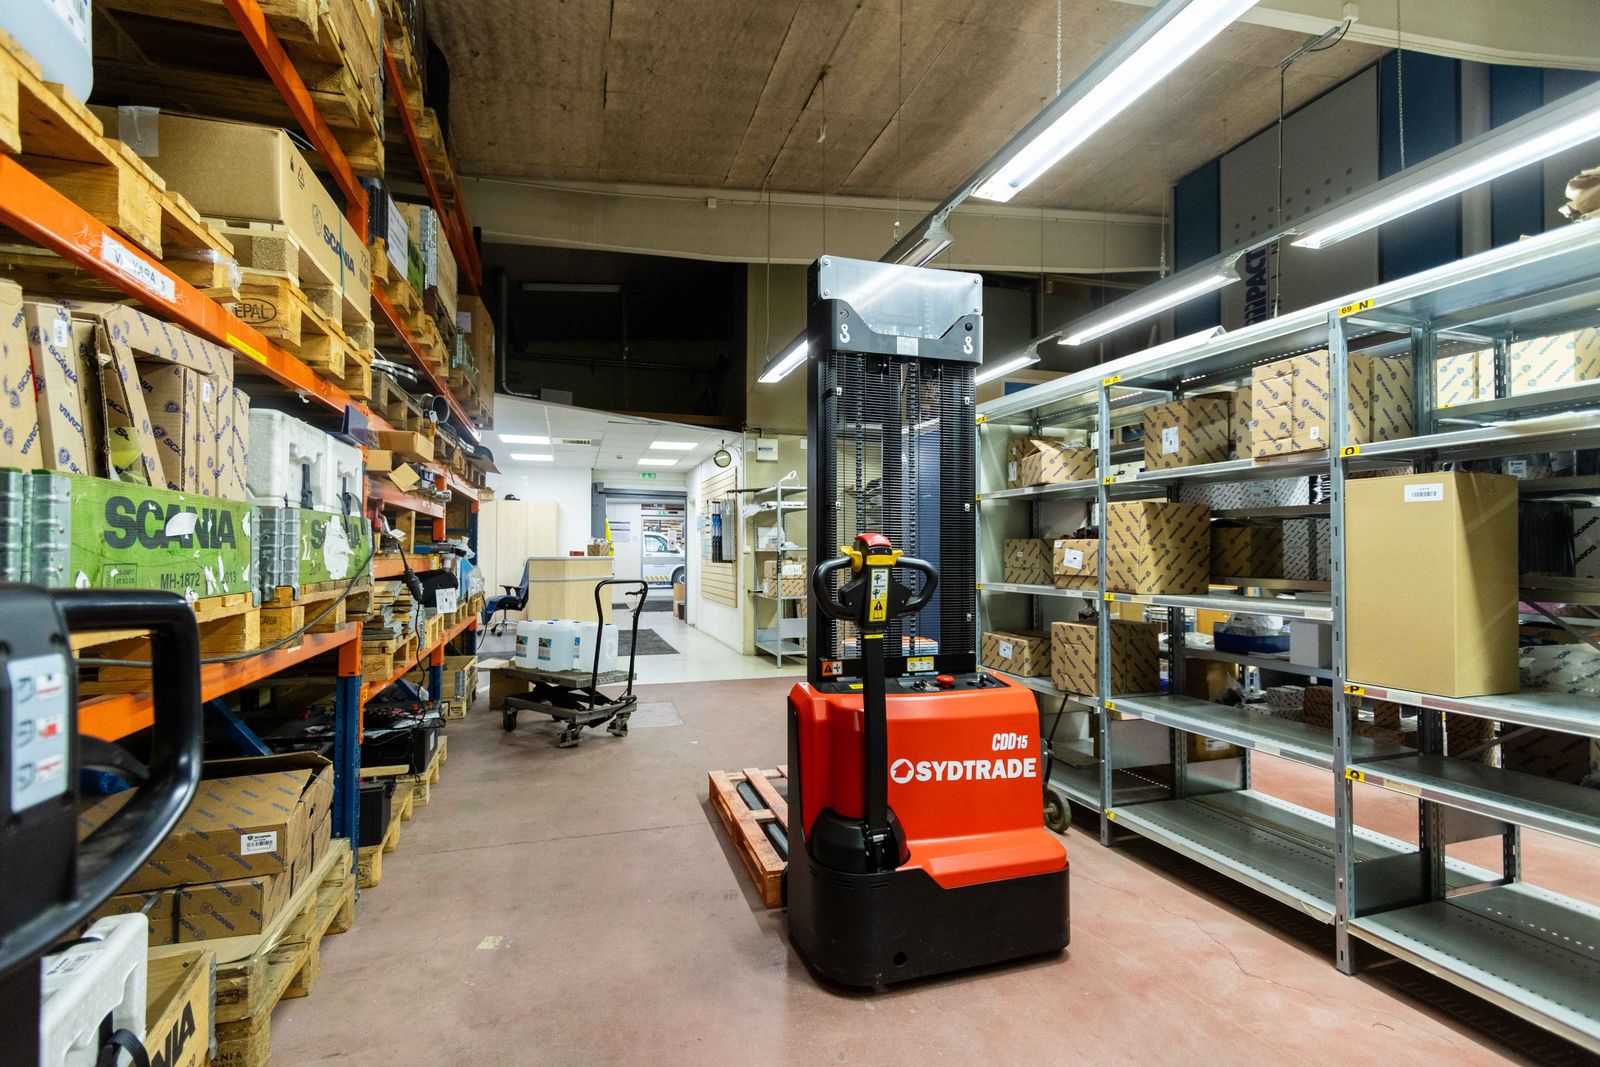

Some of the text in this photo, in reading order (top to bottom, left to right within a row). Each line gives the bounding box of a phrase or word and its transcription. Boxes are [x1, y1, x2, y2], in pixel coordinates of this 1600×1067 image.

[324, 224, 355, 276] SCANIA
[235, 302, 271, 320] EPAL
[1341, 300, 1368, 313] 69 N
[48, 344, 77, 384] SCANIA
[59, 403, 85, 439] CANIA
[1307, 404, 1326, 422] SCANIA
[20, 421, 40, 455] CANIA
[1345, 446, 1355, 456] O
[103, 495, 237, 550] SCANIA
[160, 572, 200, 590] MH-1872
[1349, 685, 1359, 693] P
[915, 757, 1037, 783] SYDTRADE
[1349, 770, 1360, 780] Q
